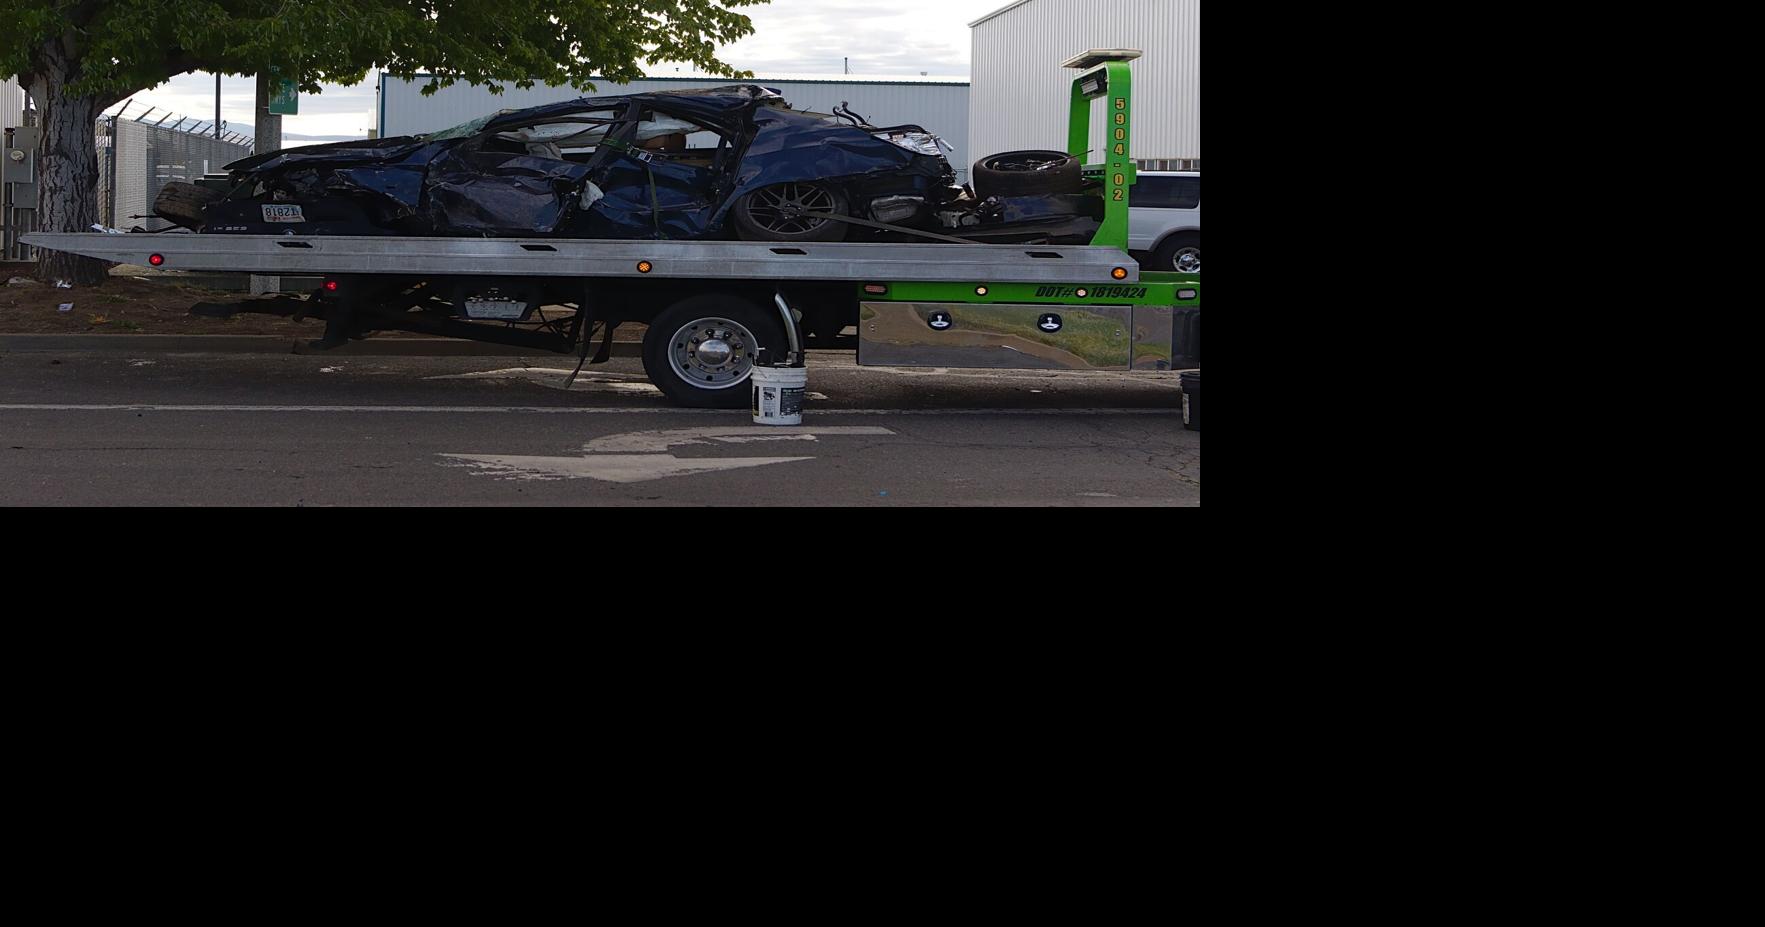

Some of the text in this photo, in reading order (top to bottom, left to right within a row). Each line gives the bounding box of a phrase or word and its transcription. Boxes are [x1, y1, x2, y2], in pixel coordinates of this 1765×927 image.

[1113, 97, 1126, 201] 5904-02
[1035, 286, 1147, 299] DOT# 1819424
